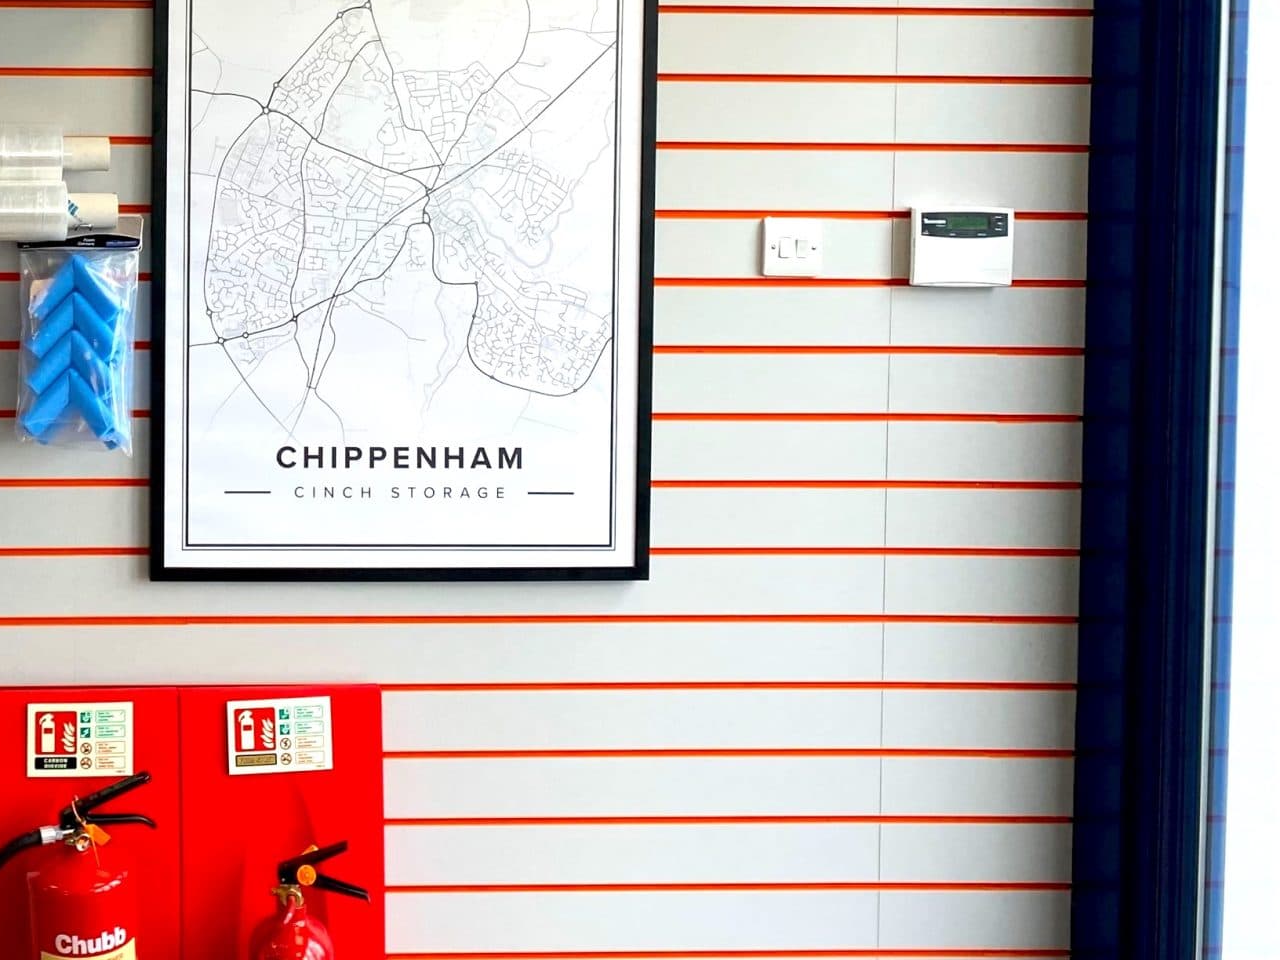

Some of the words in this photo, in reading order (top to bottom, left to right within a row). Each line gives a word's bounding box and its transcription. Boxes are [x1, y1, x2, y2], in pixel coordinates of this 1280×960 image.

[276, 446, 523, 470] CHIPPENHAM
[294, 486, 372, 499] CINCH
[391, 486, 506, 499] STORAGE
[55, 926, 127, 955] Chubb
